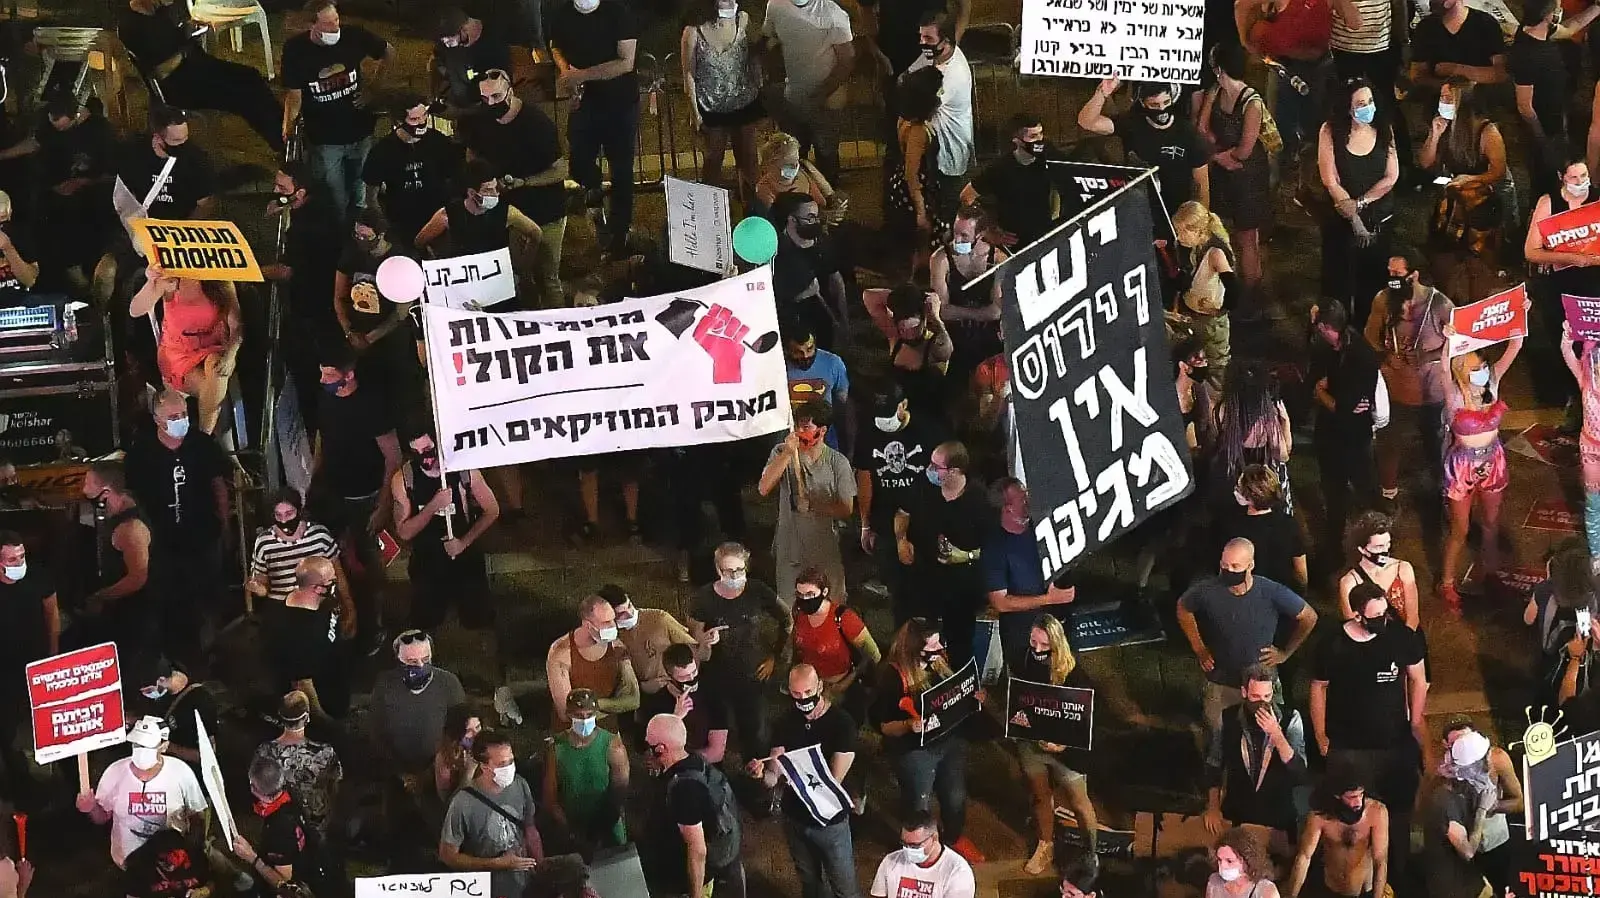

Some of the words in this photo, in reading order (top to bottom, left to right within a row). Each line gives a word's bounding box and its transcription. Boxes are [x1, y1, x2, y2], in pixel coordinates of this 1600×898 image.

[1113, 1, 1137, 15] ימין
[1142, 1, 1157, 14] של
[1161, 4, 1204, 18] אשליות
[1100, 20, 1117, 34] לא
[1177, 27, 1203, 40] אבל
[1034, 39, 1060, 56] קטן
[1069, 42, 1106, 57] בגיל
[1120, 46, 1149, 61] הבין
[1084, 62, 1113, 76] פשע
[1116, 64, 1134, 77] זה
[1141, 65, 1200, 81] שממשלה
[145, 225, 240, 246] מנותקים
[1014, 206, 1118, 331] יש
[1011, 264, 1147, 400] וירוס
[587, 330, 651, 364] את
[690, 389, 777, 430] מאבק
[1048, 346, 1160, 492] אין
[1034, 430, 1190, 581] מגיפה
[1063, 709, 1081, 721] מכל
